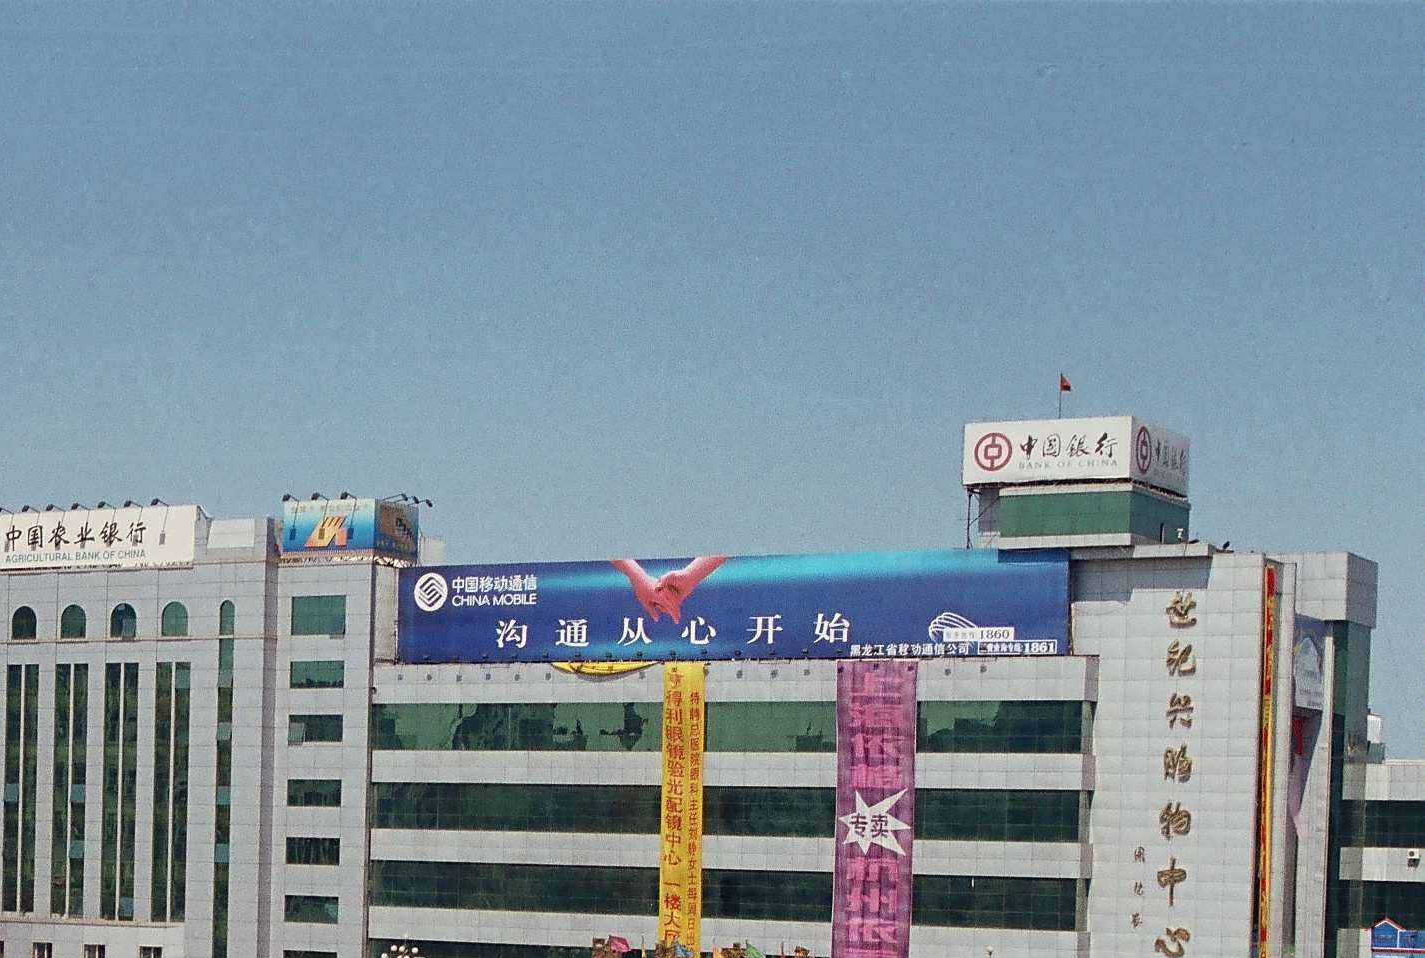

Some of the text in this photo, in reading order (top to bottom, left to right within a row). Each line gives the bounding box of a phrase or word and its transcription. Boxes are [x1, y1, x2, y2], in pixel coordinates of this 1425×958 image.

[1020, 432, 1119, 459] 中国银行
[1019, 461, 1051, 470] BANK
[1081, 458, 1118, 468] CHINA
[5, 520, 147, 551] 中国农业银行
[5, 549, 147, 564] AGRICULTURAL BANK OF CHINA
[452, 574, 538, 593] 中国移动通信
[452, 593, 537, 607] CHINA MOBILE
[496, 612, 851, 649] 沟通从心开始
[979, 629, 1011, 640] 1860
[850, 641, 970, 657] 黑龙江省移动通信公司
[1024, 642, 1056, 655] 1861
[849, 814, 888, 838] 专卖
